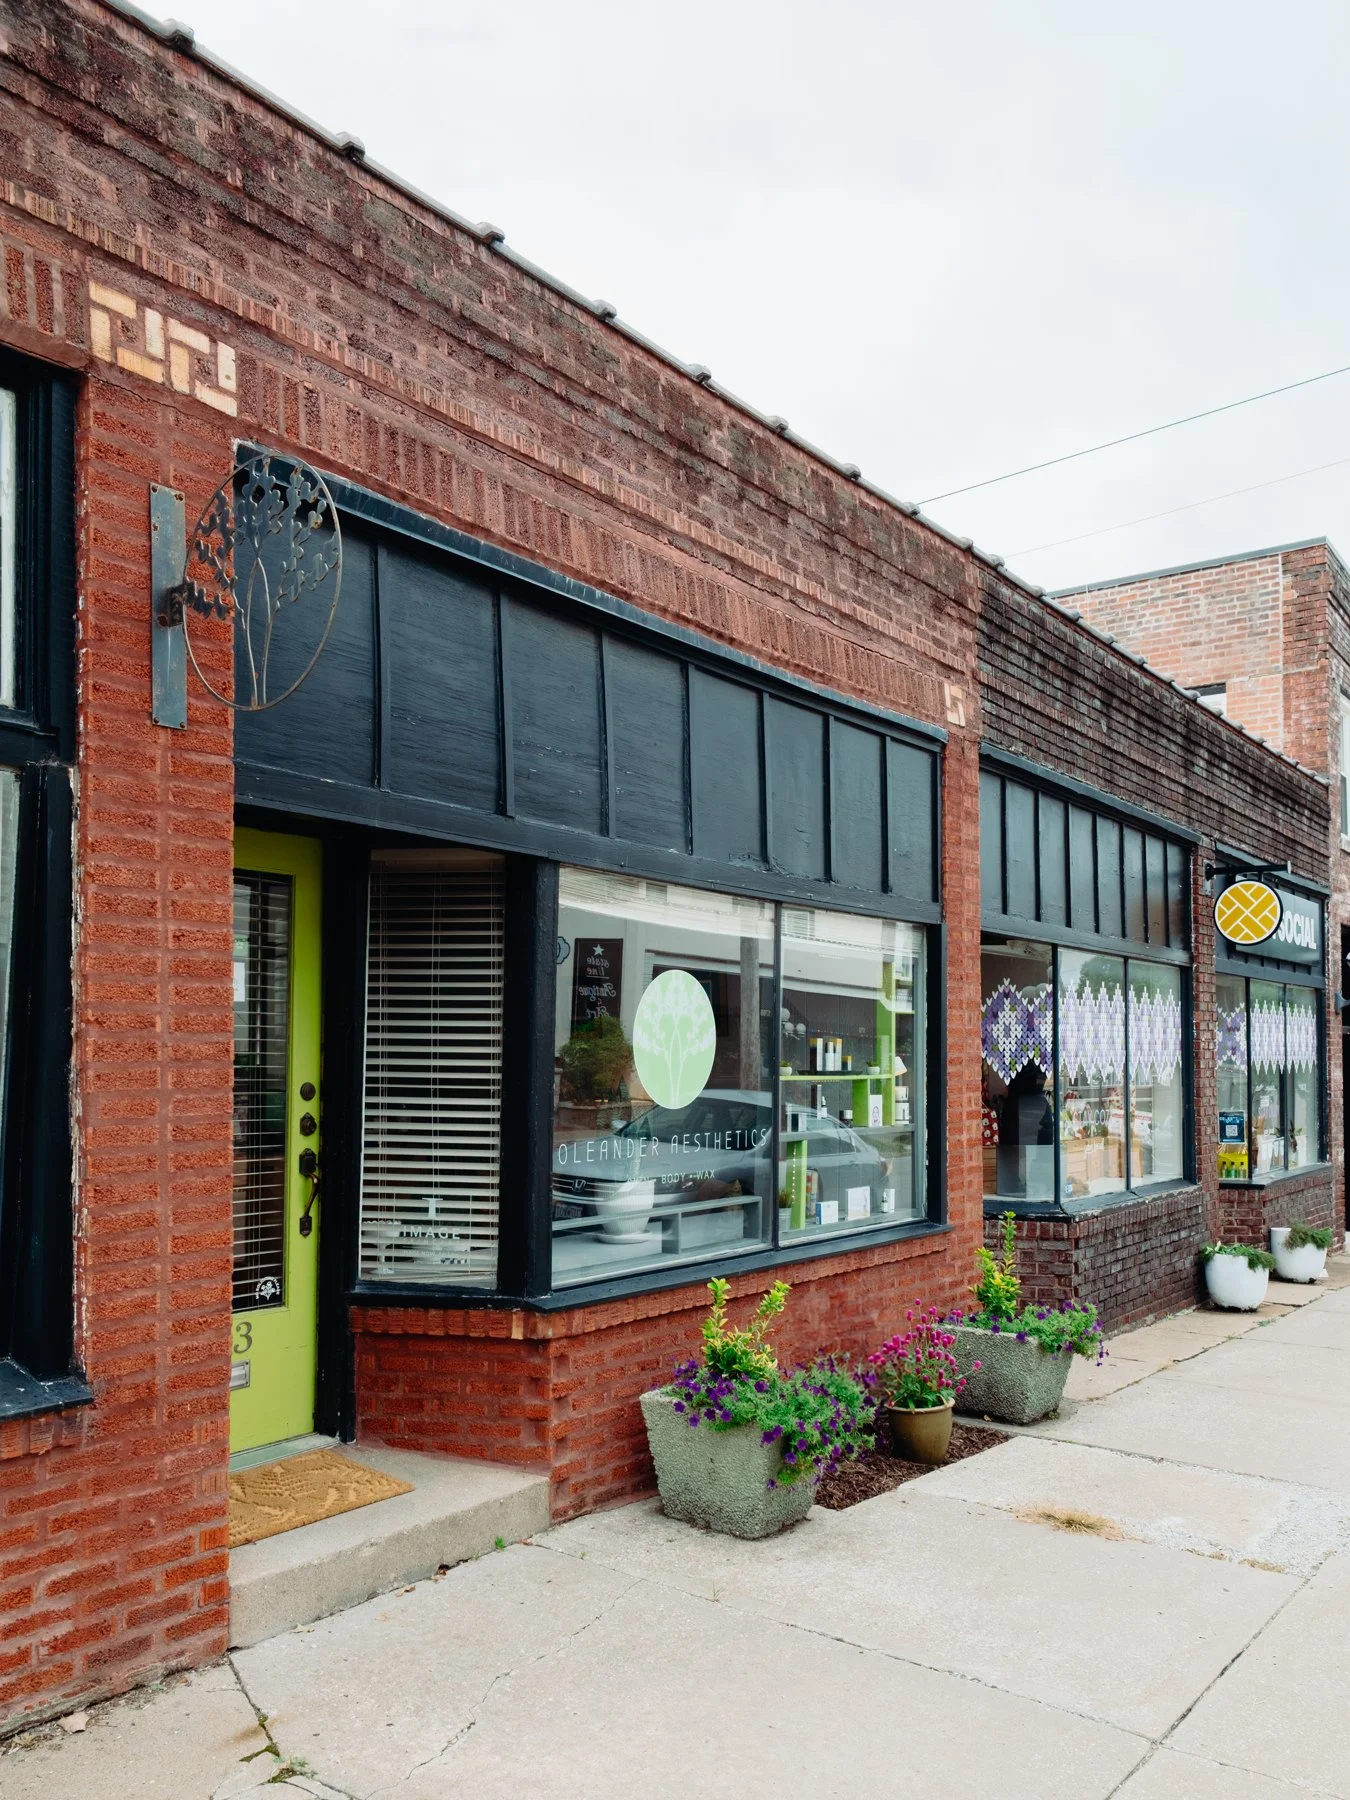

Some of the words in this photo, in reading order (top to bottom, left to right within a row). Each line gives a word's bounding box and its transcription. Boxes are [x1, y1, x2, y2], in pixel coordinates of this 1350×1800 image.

[1278, 910, 1317, 950] SOCIAL
[558, 1136, 659, 1165] OLEANDER
[671, 1128, 767, 1154] AESTHETICS
[661, 1172, 686, 1184] BODY
[696, 1169, 715, 1180] WAX
[402, 1225, 461, 1240] IMAGE
[233, 1321, 253, 1354] 3
